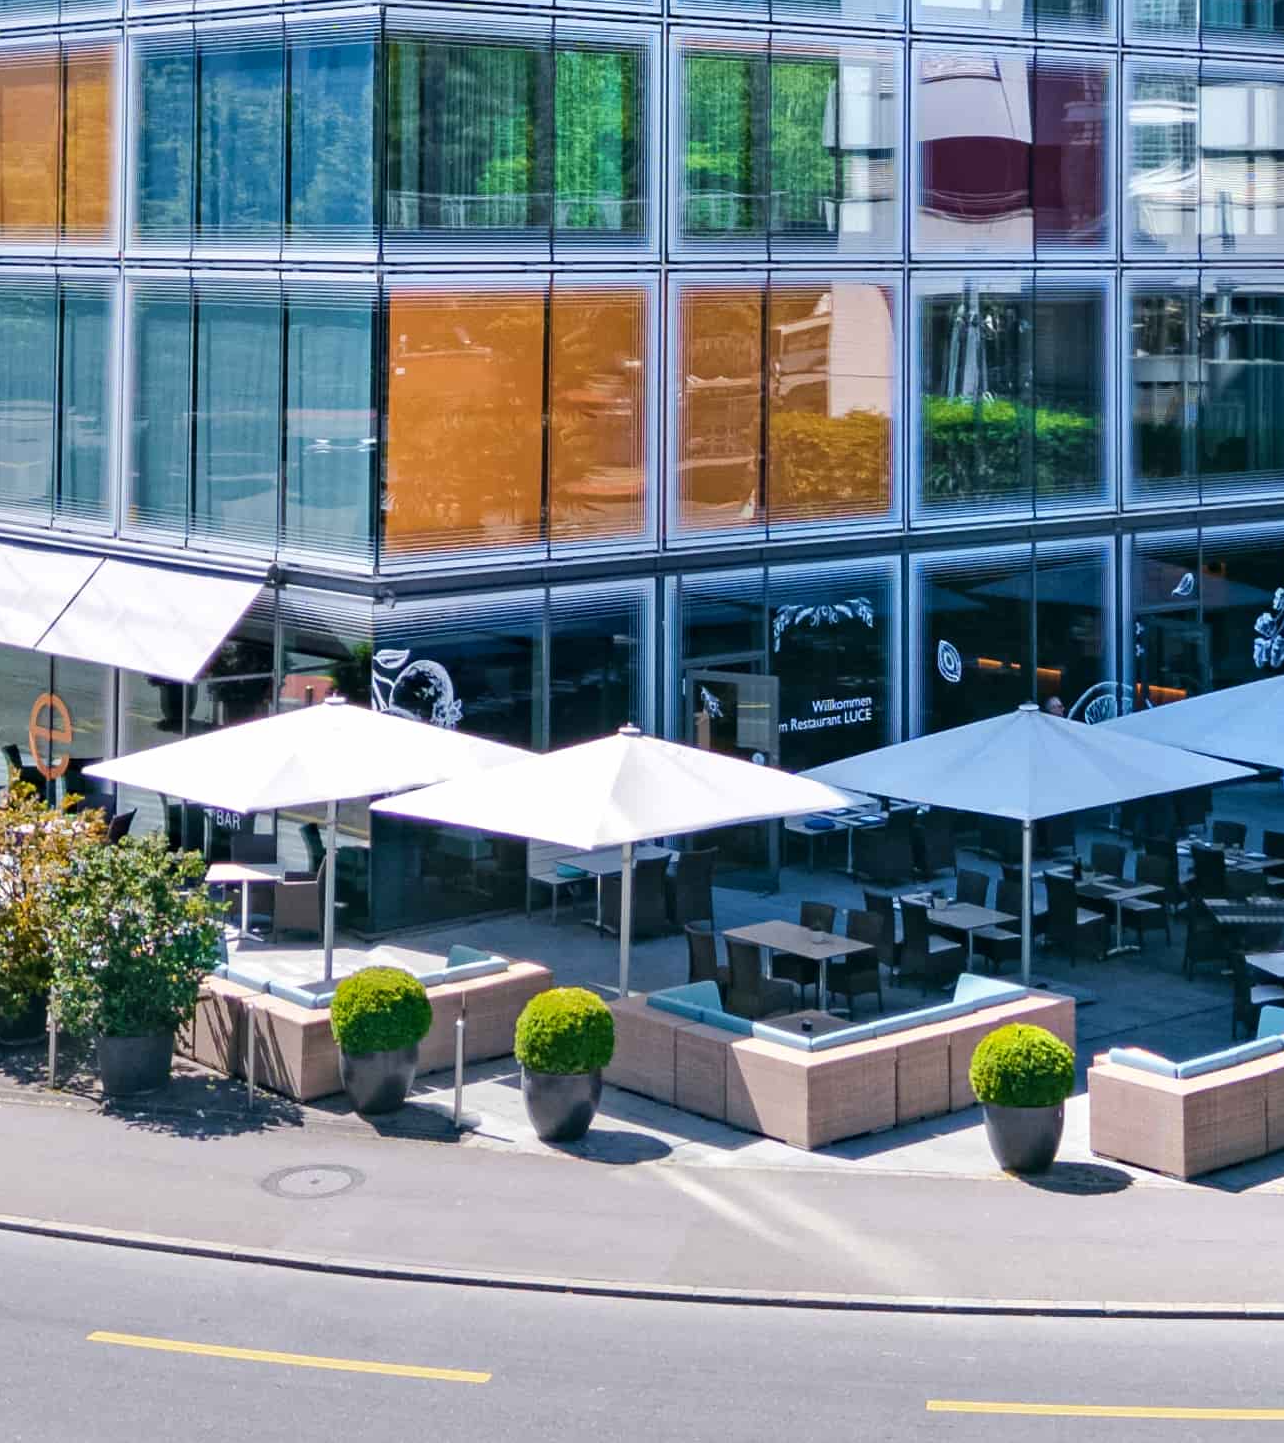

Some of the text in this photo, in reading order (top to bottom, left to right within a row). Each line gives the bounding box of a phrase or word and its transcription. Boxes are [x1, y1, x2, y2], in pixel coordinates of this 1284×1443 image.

[812, 697, 872, 713] Willkommen
[778, 708, 872, 733] m Restaurant LUCE
[216, 809, 241, 830] BAR
